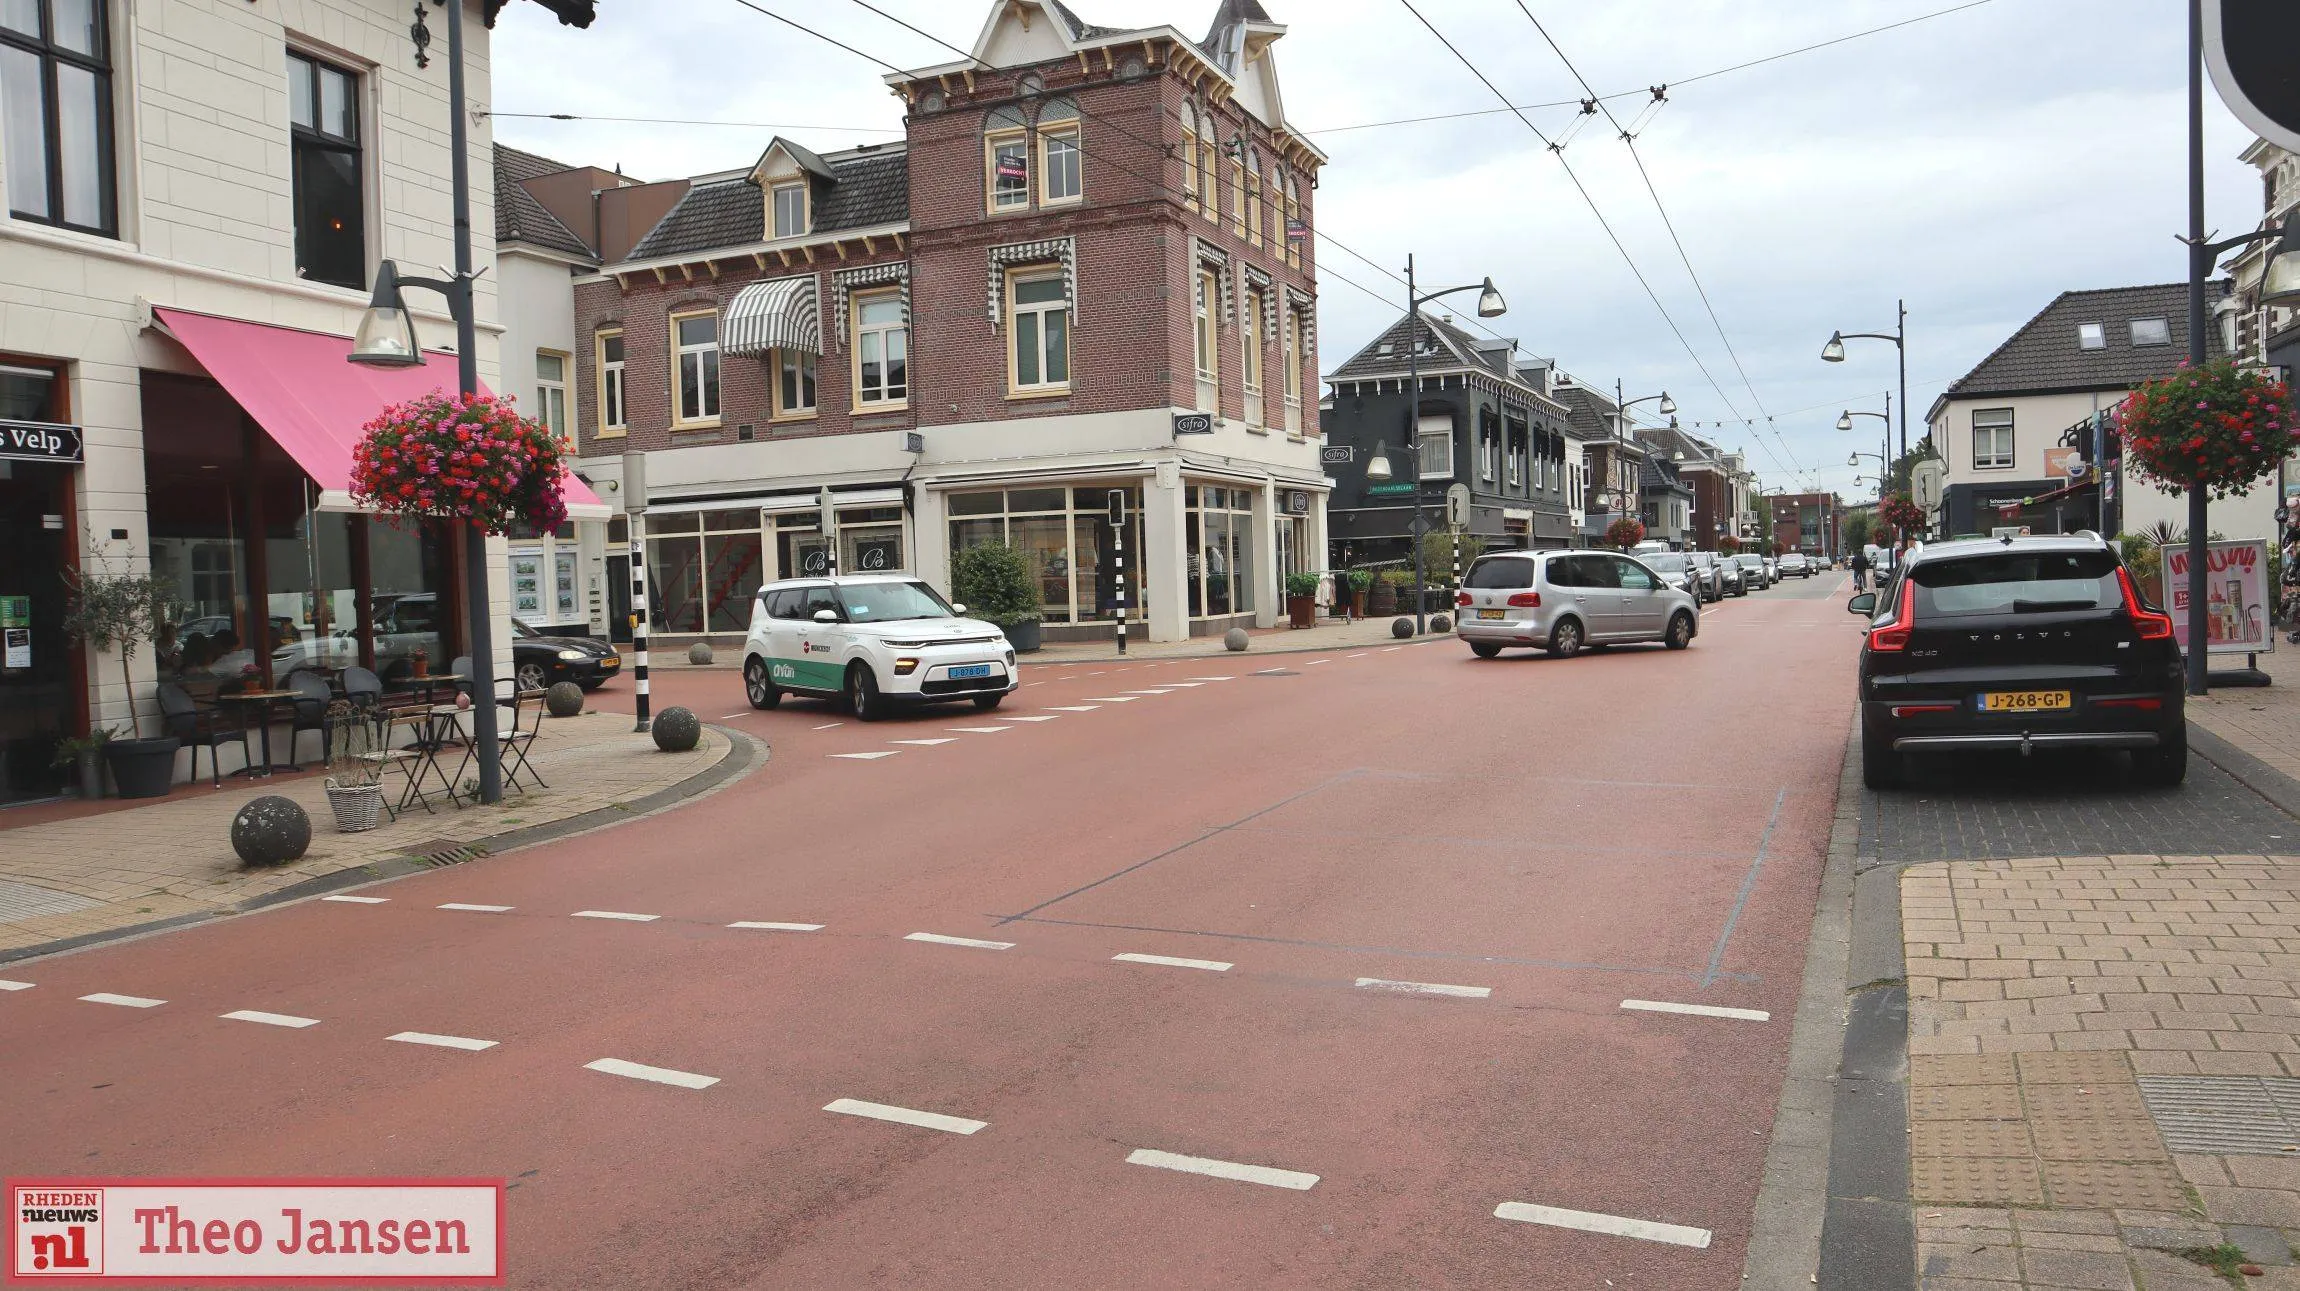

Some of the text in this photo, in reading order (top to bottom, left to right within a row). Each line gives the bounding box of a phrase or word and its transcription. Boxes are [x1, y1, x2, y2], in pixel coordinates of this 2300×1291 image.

[1182, 417, 1203, 431] sifra
[10, 429, 62, 454] Velp
[805, 551, 825, 571] B
[863, 548, 884, 569] B
[2169, 546, 2257, 576] WUW!
[1969, 630, 2071, 641] VOLVO
[1992, 693, 2065, 708] J-268-GP
